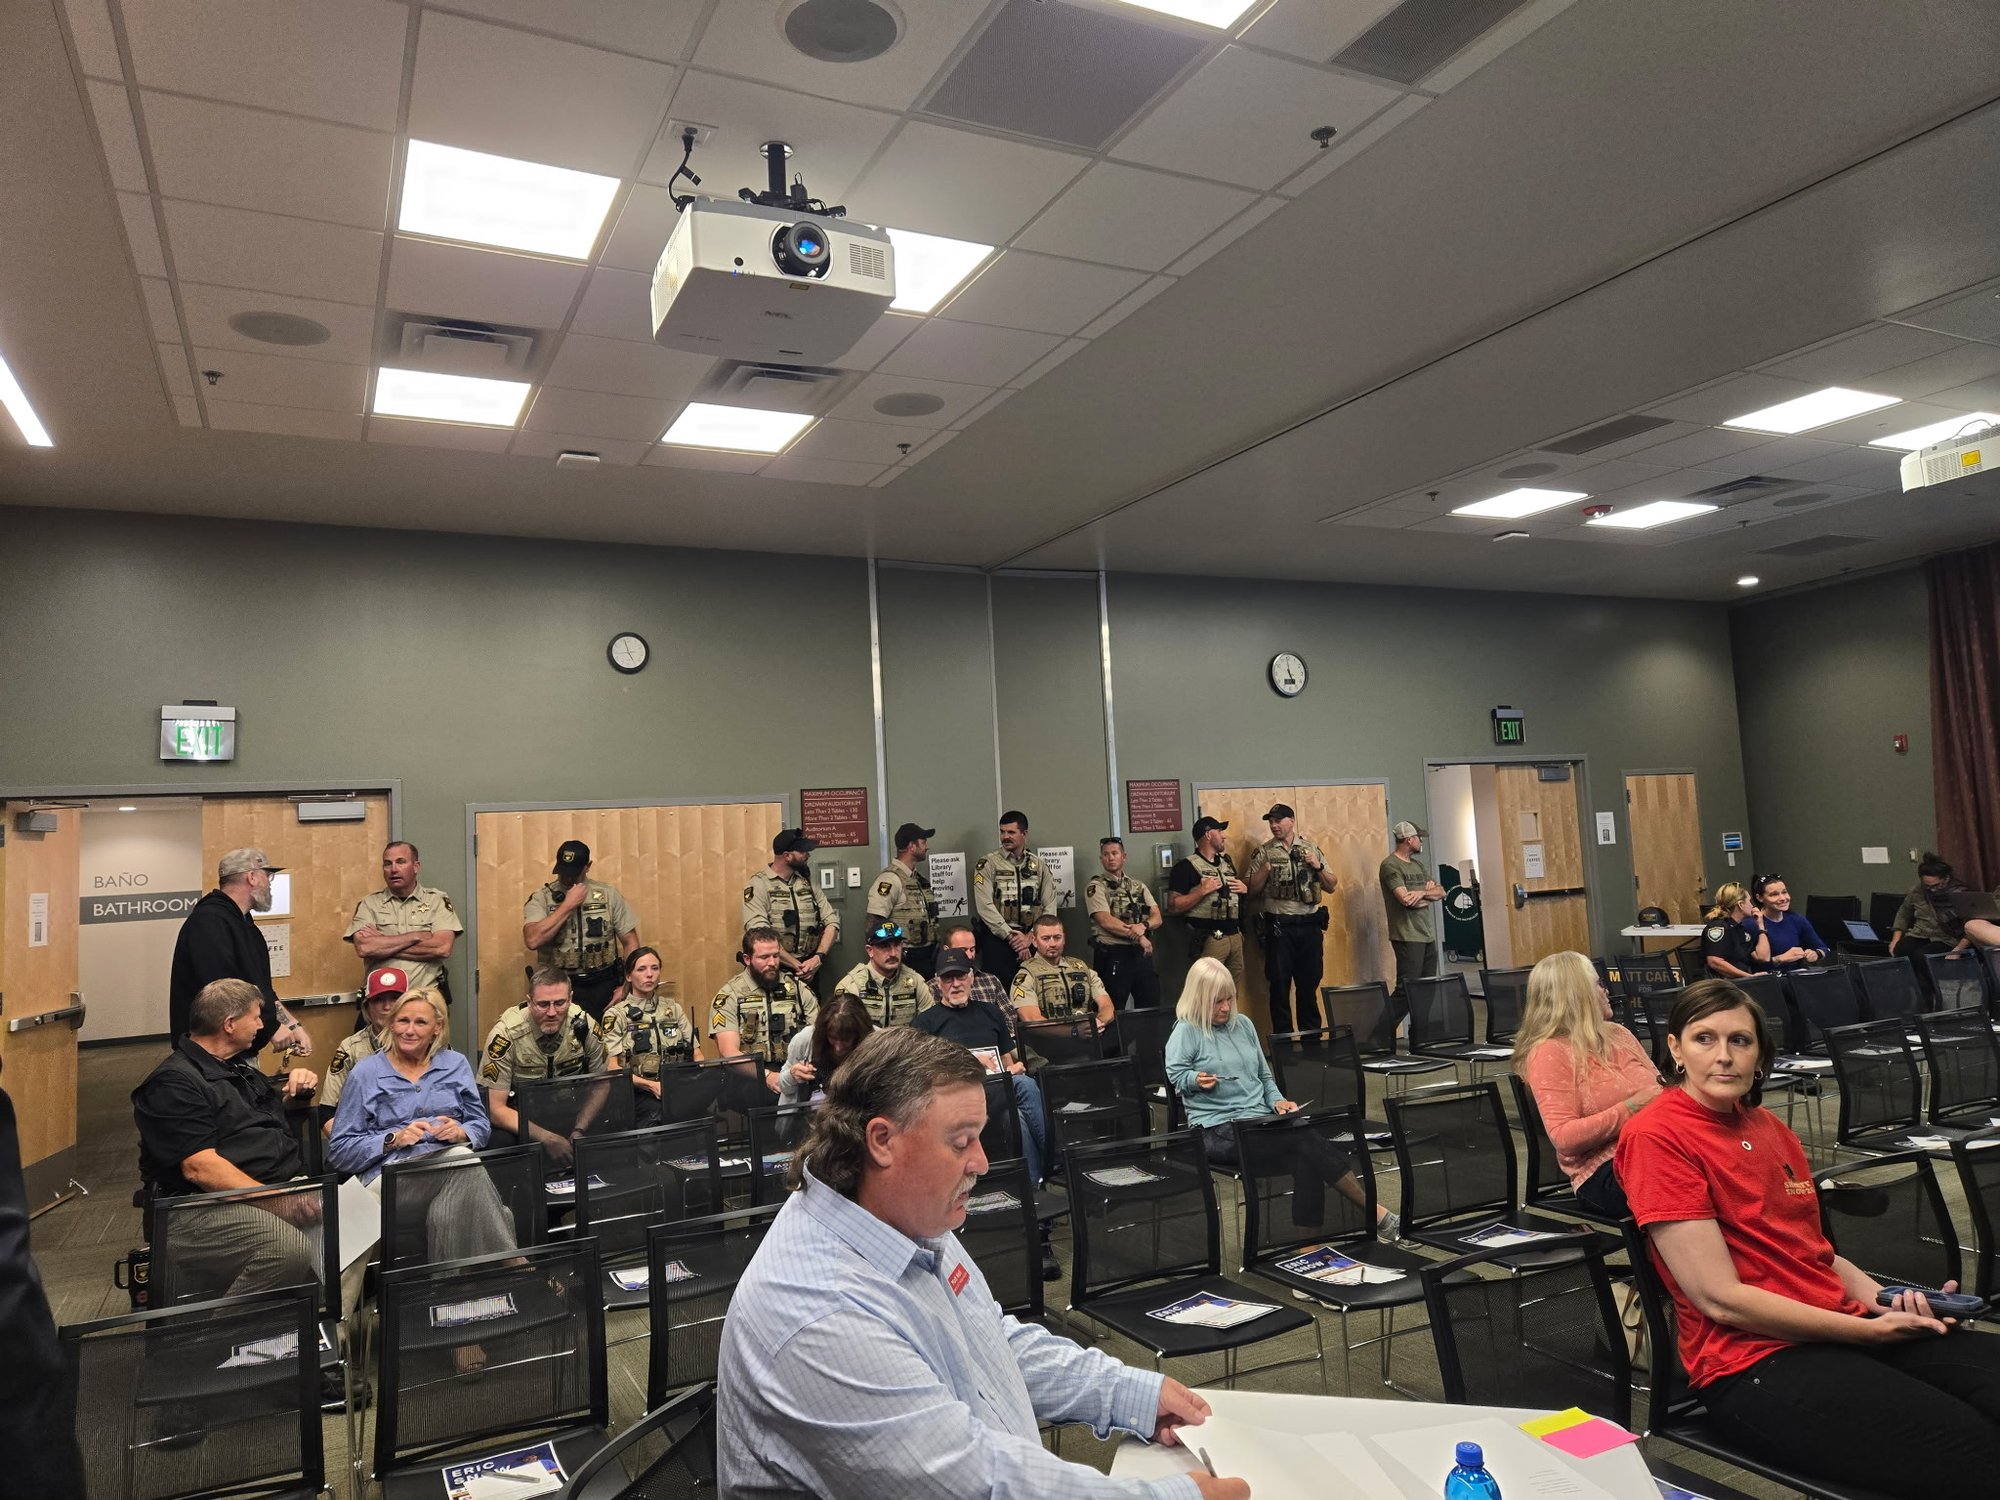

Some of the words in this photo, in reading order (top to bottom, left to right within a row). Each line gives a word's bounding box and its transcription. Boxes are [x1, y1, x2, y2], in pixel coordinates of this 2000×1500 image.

[1501, 721, 1520, 740] EXIT
[176, 726, 224, 756] EXIT
[94, 871, 149, 889] BAÑO
[93, 897, 199, 917] BATHROOM
[451, 1461, 495, 1478] ERIC
[453, 1464, 512, 1486] SNW
